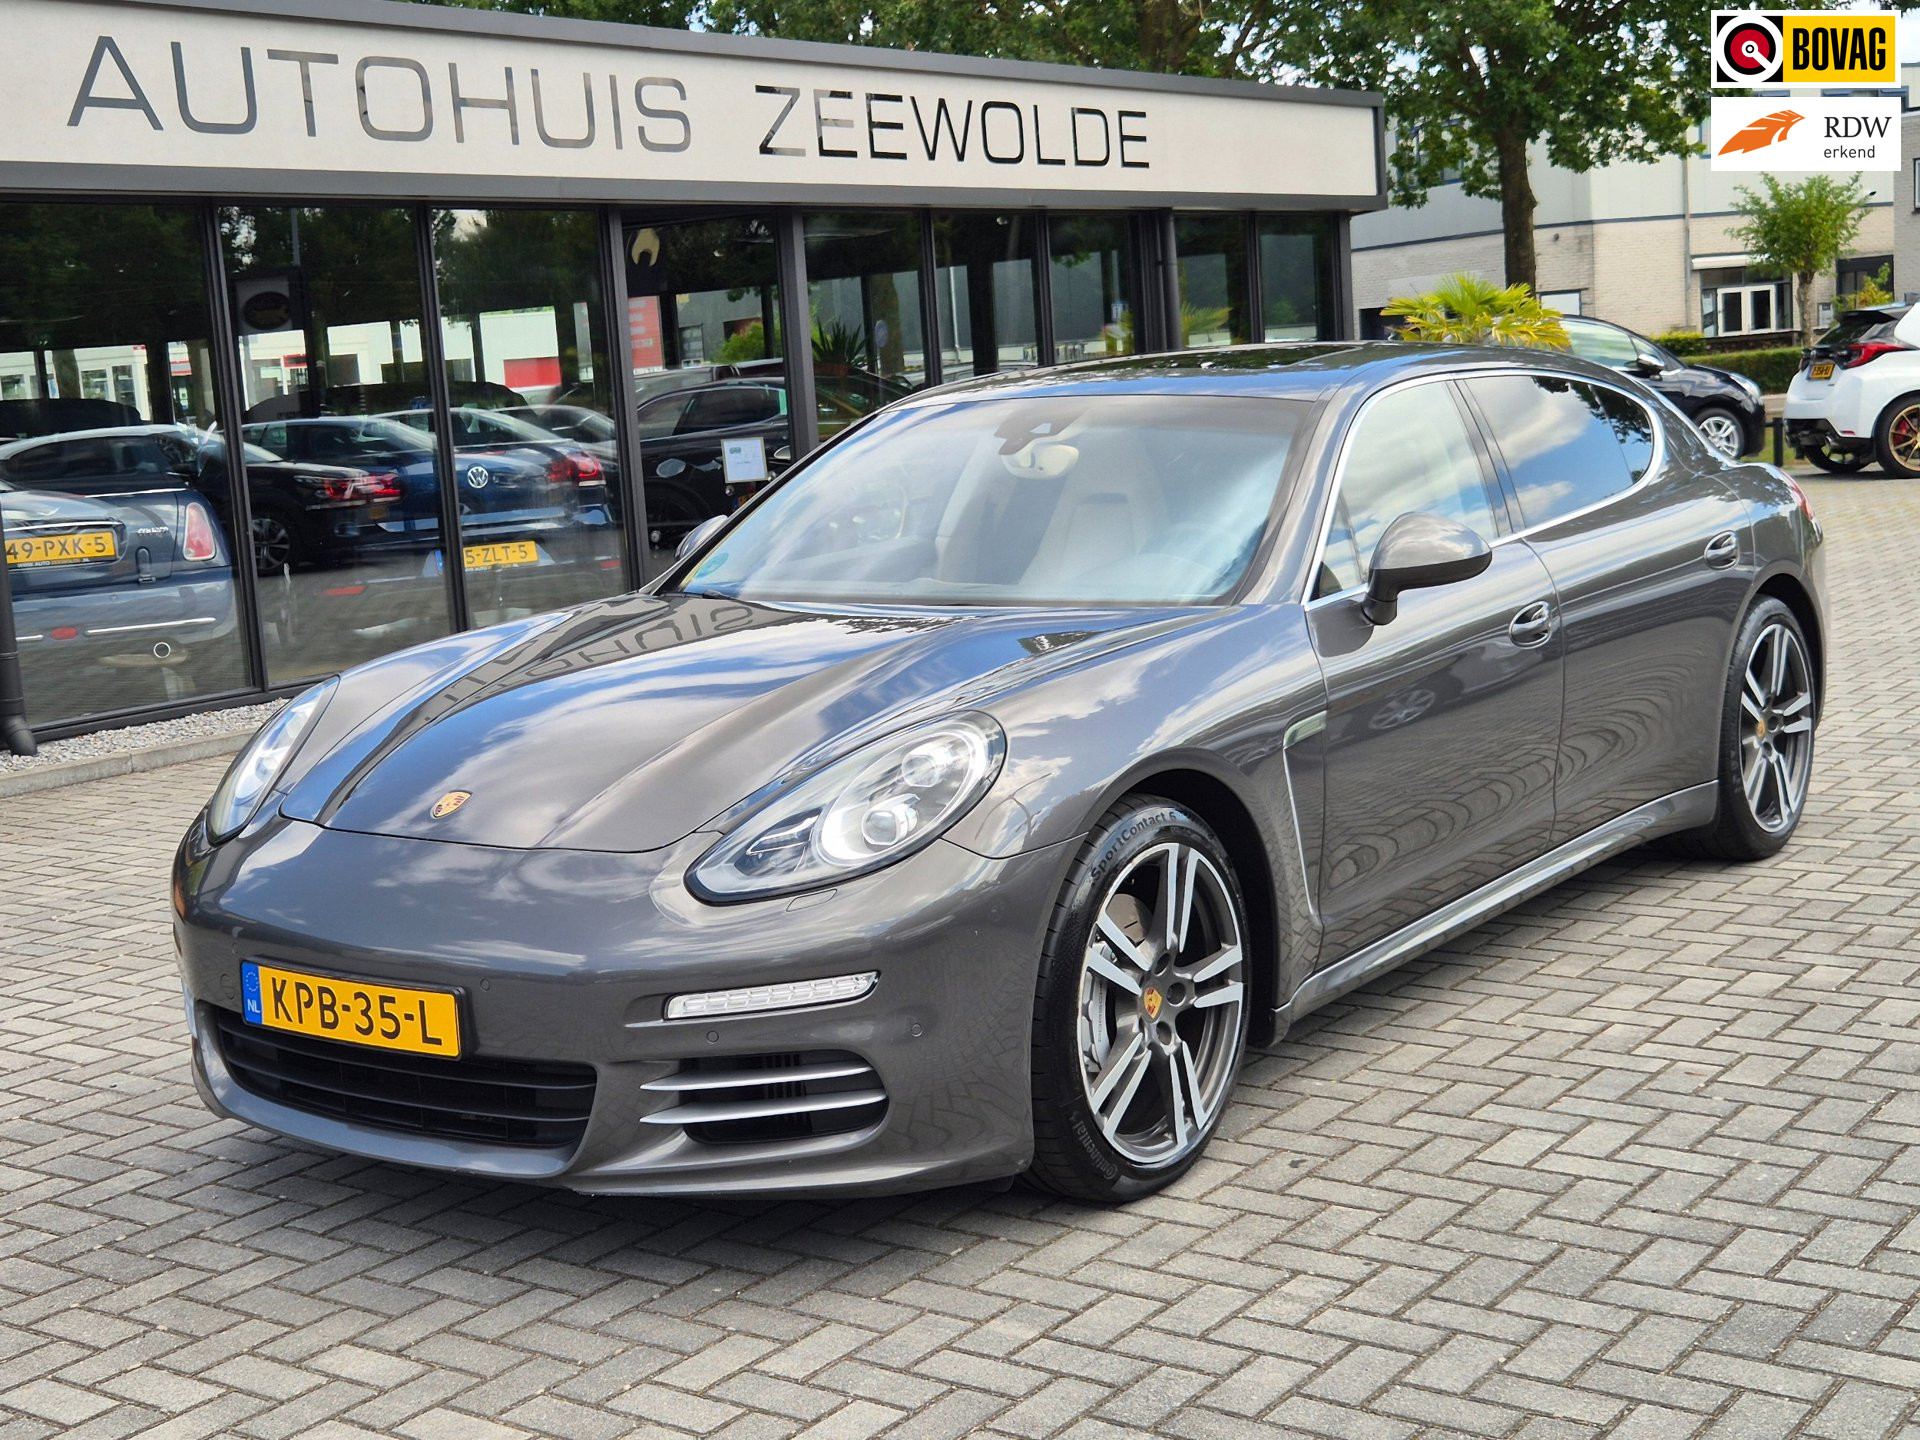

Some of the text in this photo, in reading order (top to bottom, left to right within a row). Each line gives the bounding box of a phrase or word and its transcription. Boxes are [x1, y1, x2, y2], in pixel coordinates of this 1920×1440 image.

[67, 35, 1149, 168] AUTOHUIS ZEEWOLDE
[6, 536, 108, 561] 49-PXK-5
[464, 544, 528, 565] 5-ZLT-5
[1091, 812, 1166, 882] SportContact
[247, 999, 261, 1014] NL
[271, 977, 443, 1046] KPB-35-L
[1072, 1120, 1118, 1180] Continental
